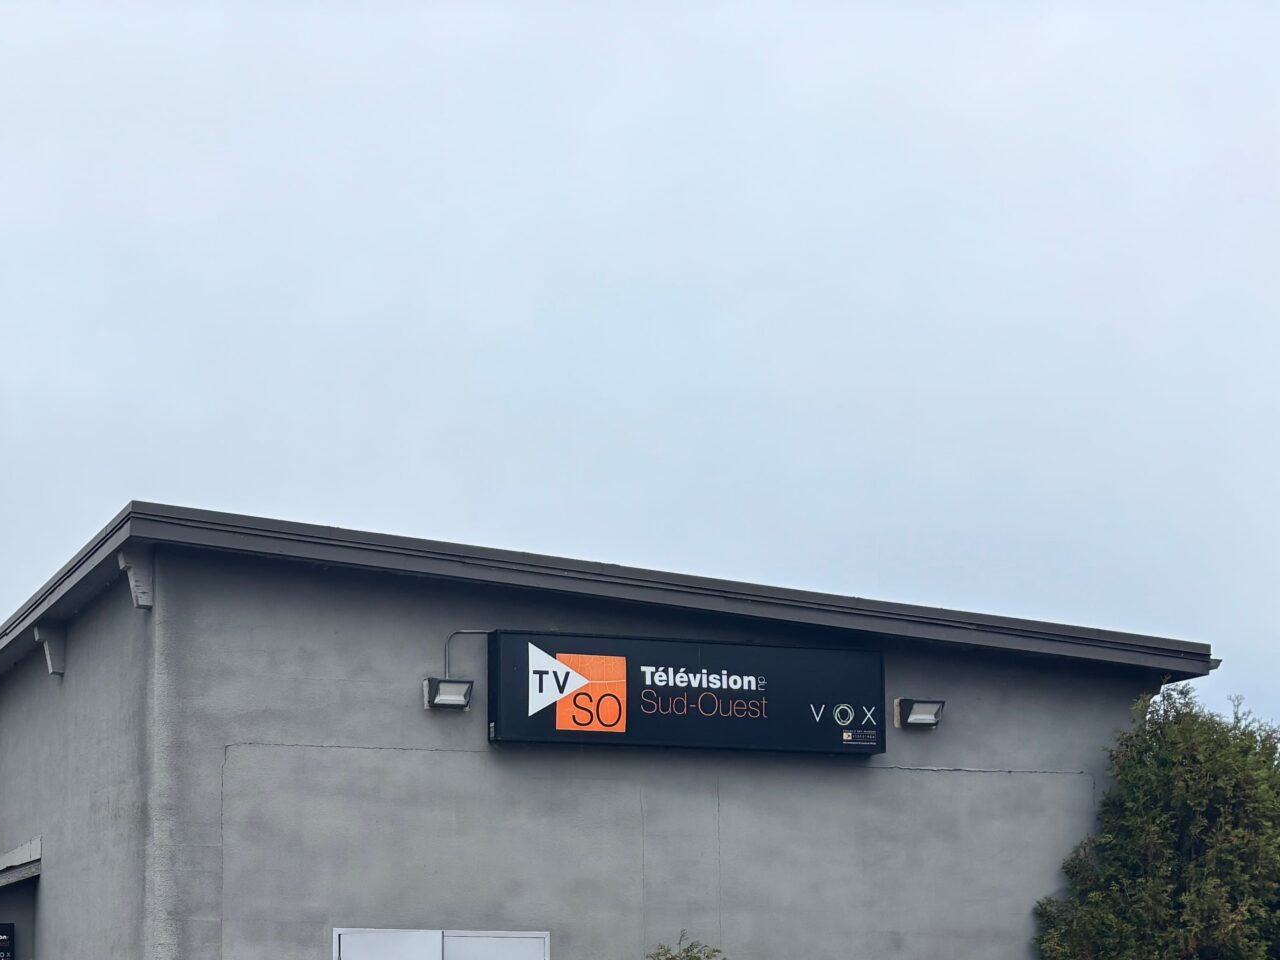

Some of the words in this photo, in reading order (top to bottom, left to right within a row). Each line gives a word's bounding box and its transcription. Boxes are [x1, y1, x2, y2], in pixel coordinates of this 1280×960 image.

[533, 670, 570, 694] TV
[640, 666, 756, 690] Télévision
[572, 692, 622, 727] SO
[640, 689, 768, 718] Sud-Ouest
[810, 703, 877, 725] VOX
